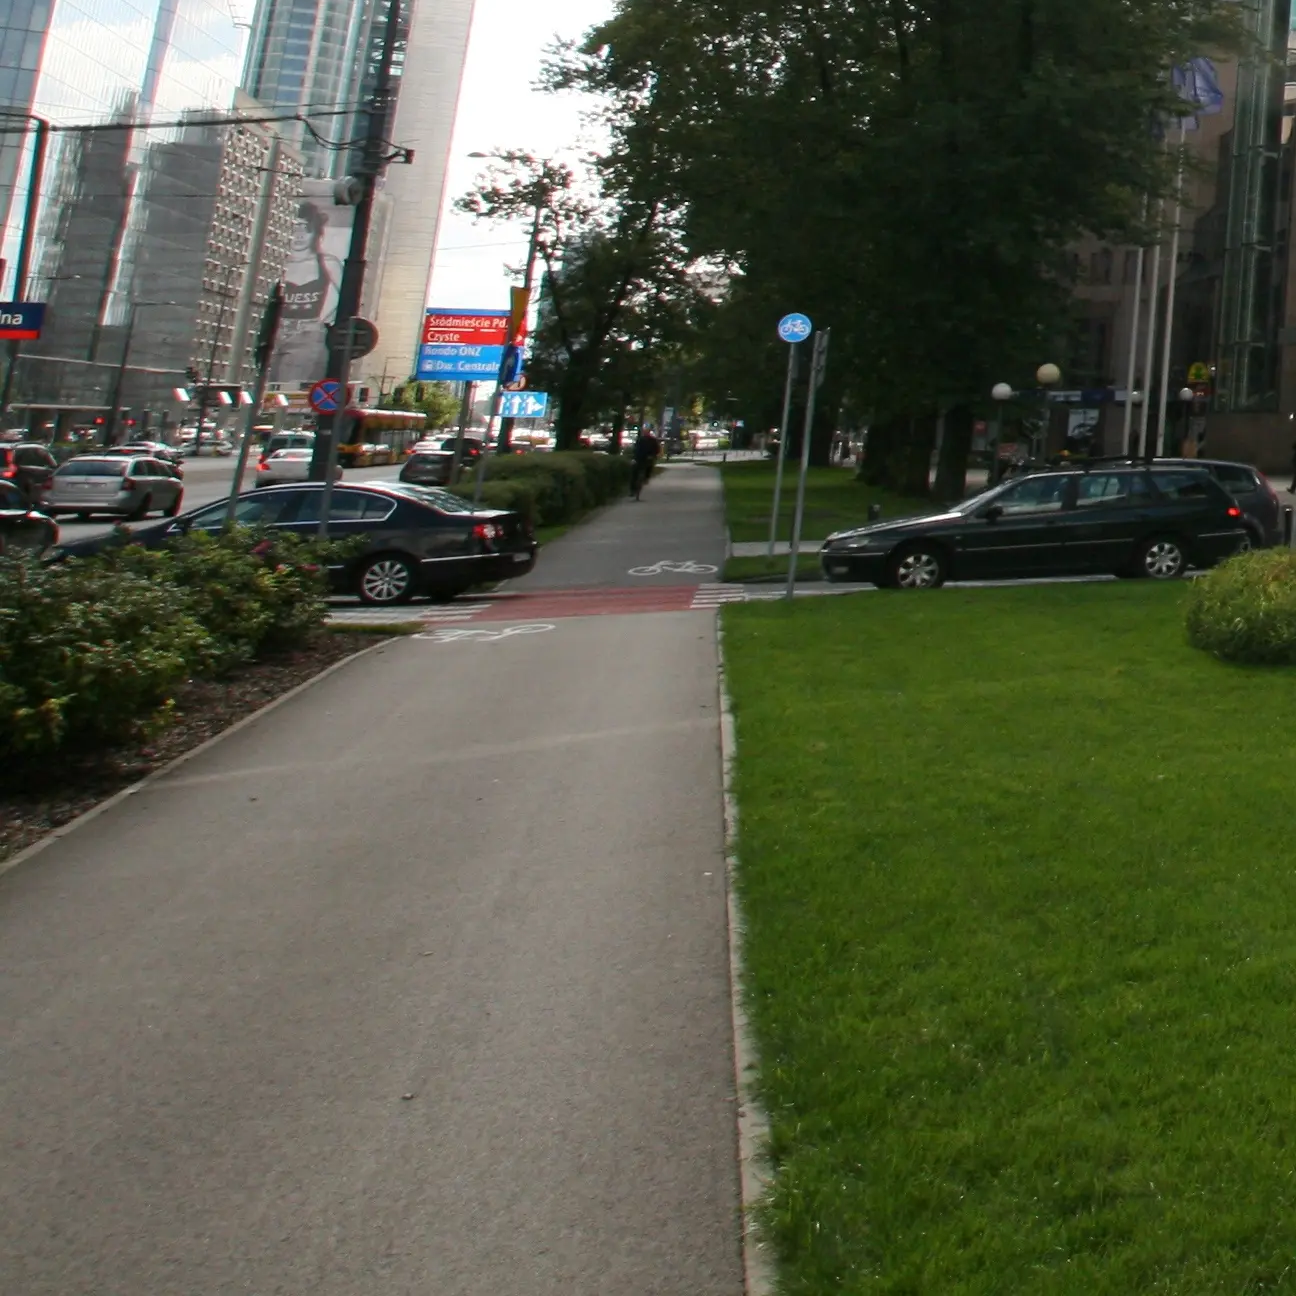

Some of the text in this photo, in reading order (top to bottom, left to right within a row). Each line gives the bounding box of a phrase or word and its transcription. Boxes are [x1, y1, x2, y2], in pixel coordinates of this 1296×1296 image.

[284, 291, 320, 303] UESS
[0, 309, 24, 325] na
[427, 332, 460, 341] Czyste
[459, 347, 481, 356] ONZ
